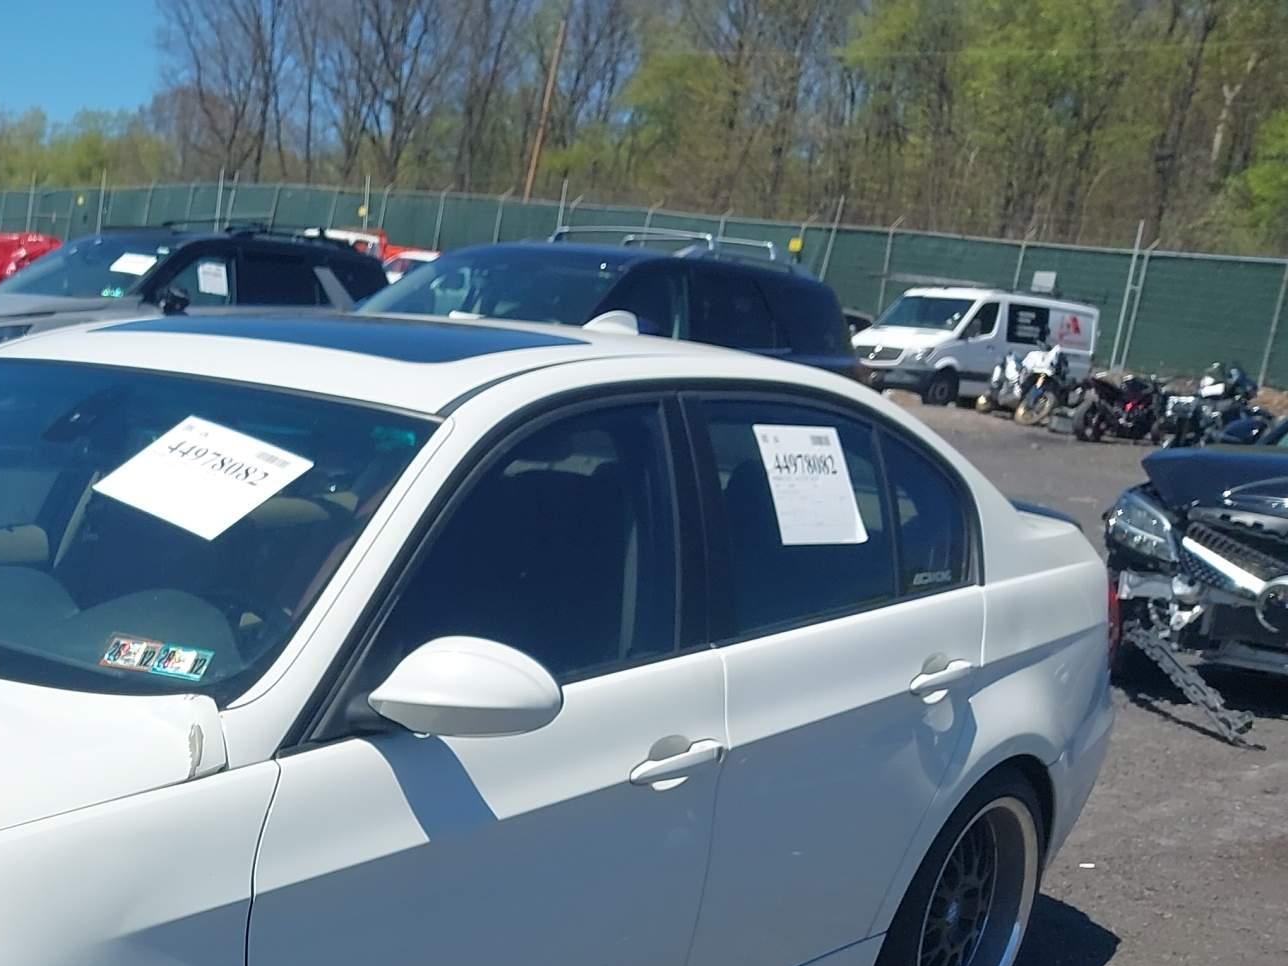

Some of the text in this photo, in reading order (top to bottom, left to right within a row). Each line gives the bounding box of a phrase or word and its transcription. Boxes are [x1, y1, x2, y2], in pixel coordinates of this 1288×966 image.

[168, 440, 270, 486] 44978082
[775, 453, 838, 475] 44978082
[139, 648, 156, 667] 12
[188, 657, 208, 676] 12
